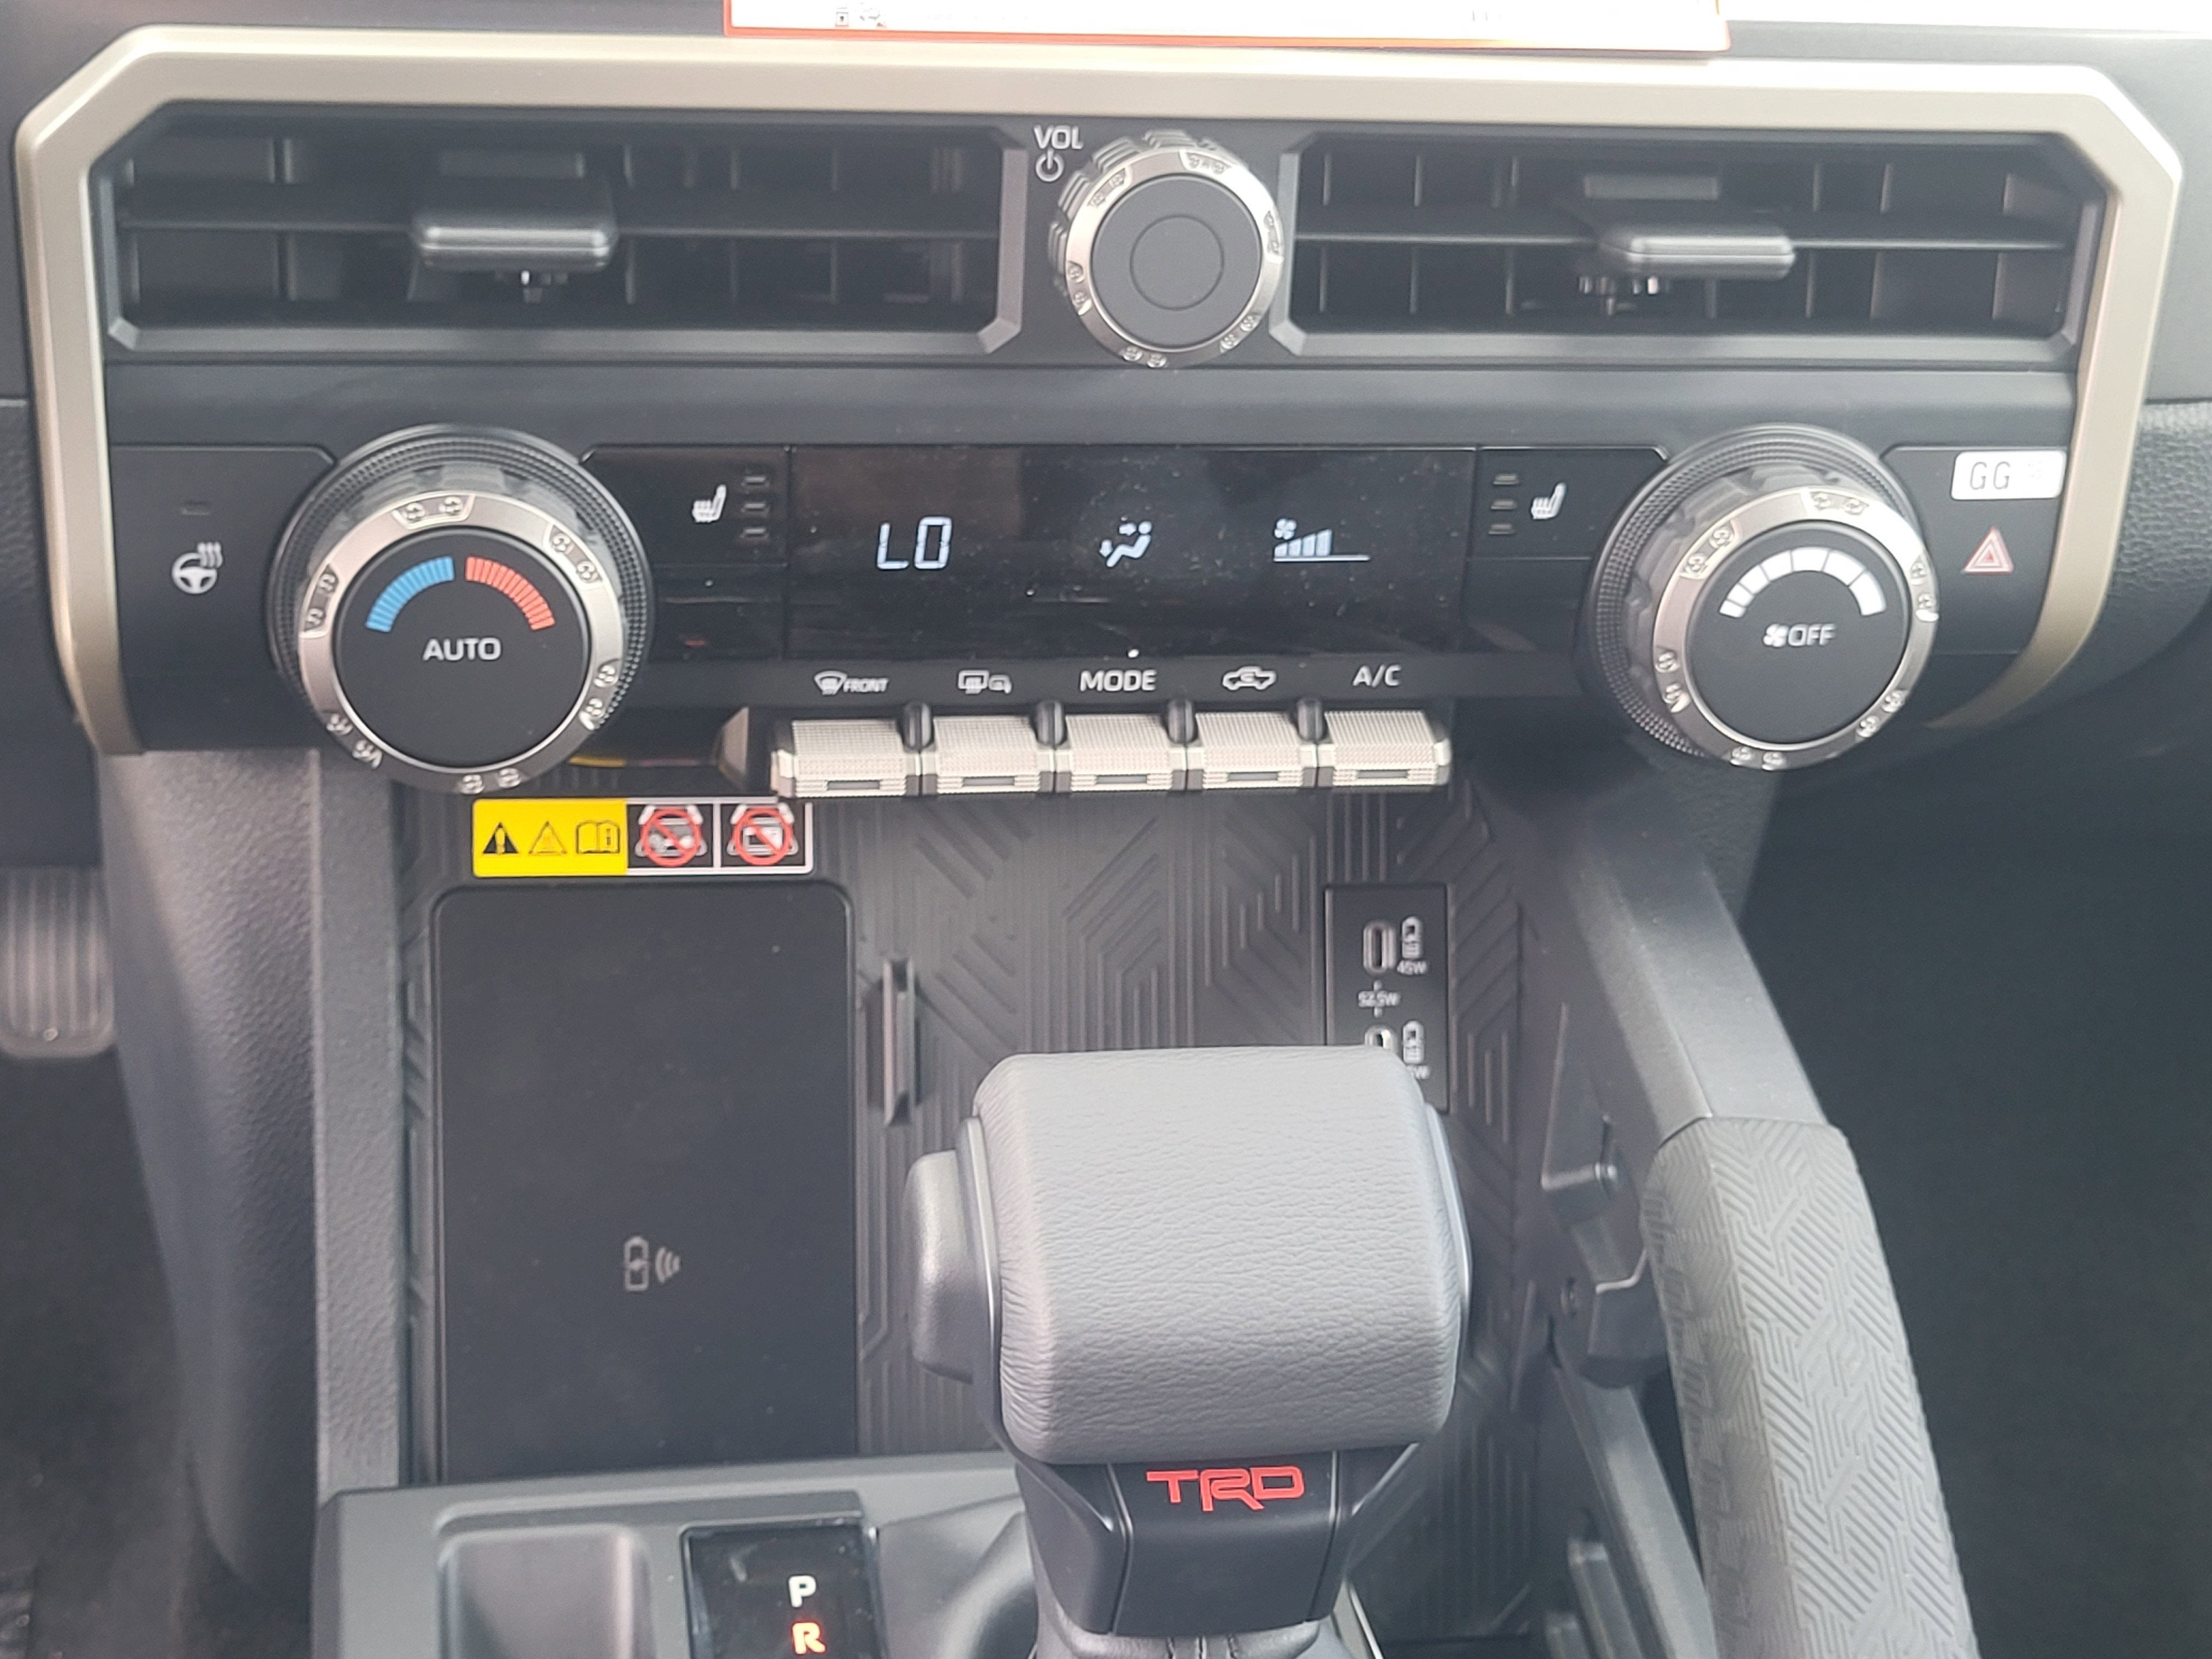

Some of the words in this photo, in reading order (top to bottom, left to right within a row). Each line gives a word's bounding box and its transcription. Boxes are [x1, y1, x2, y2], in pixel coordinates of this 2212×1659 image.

[1034, 126, 1082, 149] VOL
[1969, 461, 2011, 491] GG
[1788, 624, 1835, 646] OFF
[423, 637, 501, 661] AUTO
[843, 677, 889, 692] FRONT
[1079, 669, 1156, 692] MODE
[1353, 665, 1401, 687] A/C
[1146, 1465, 1305, 1512] TRD
[788, 1575, 816, 1608] P
[791, 1621, 826, 1655] R
